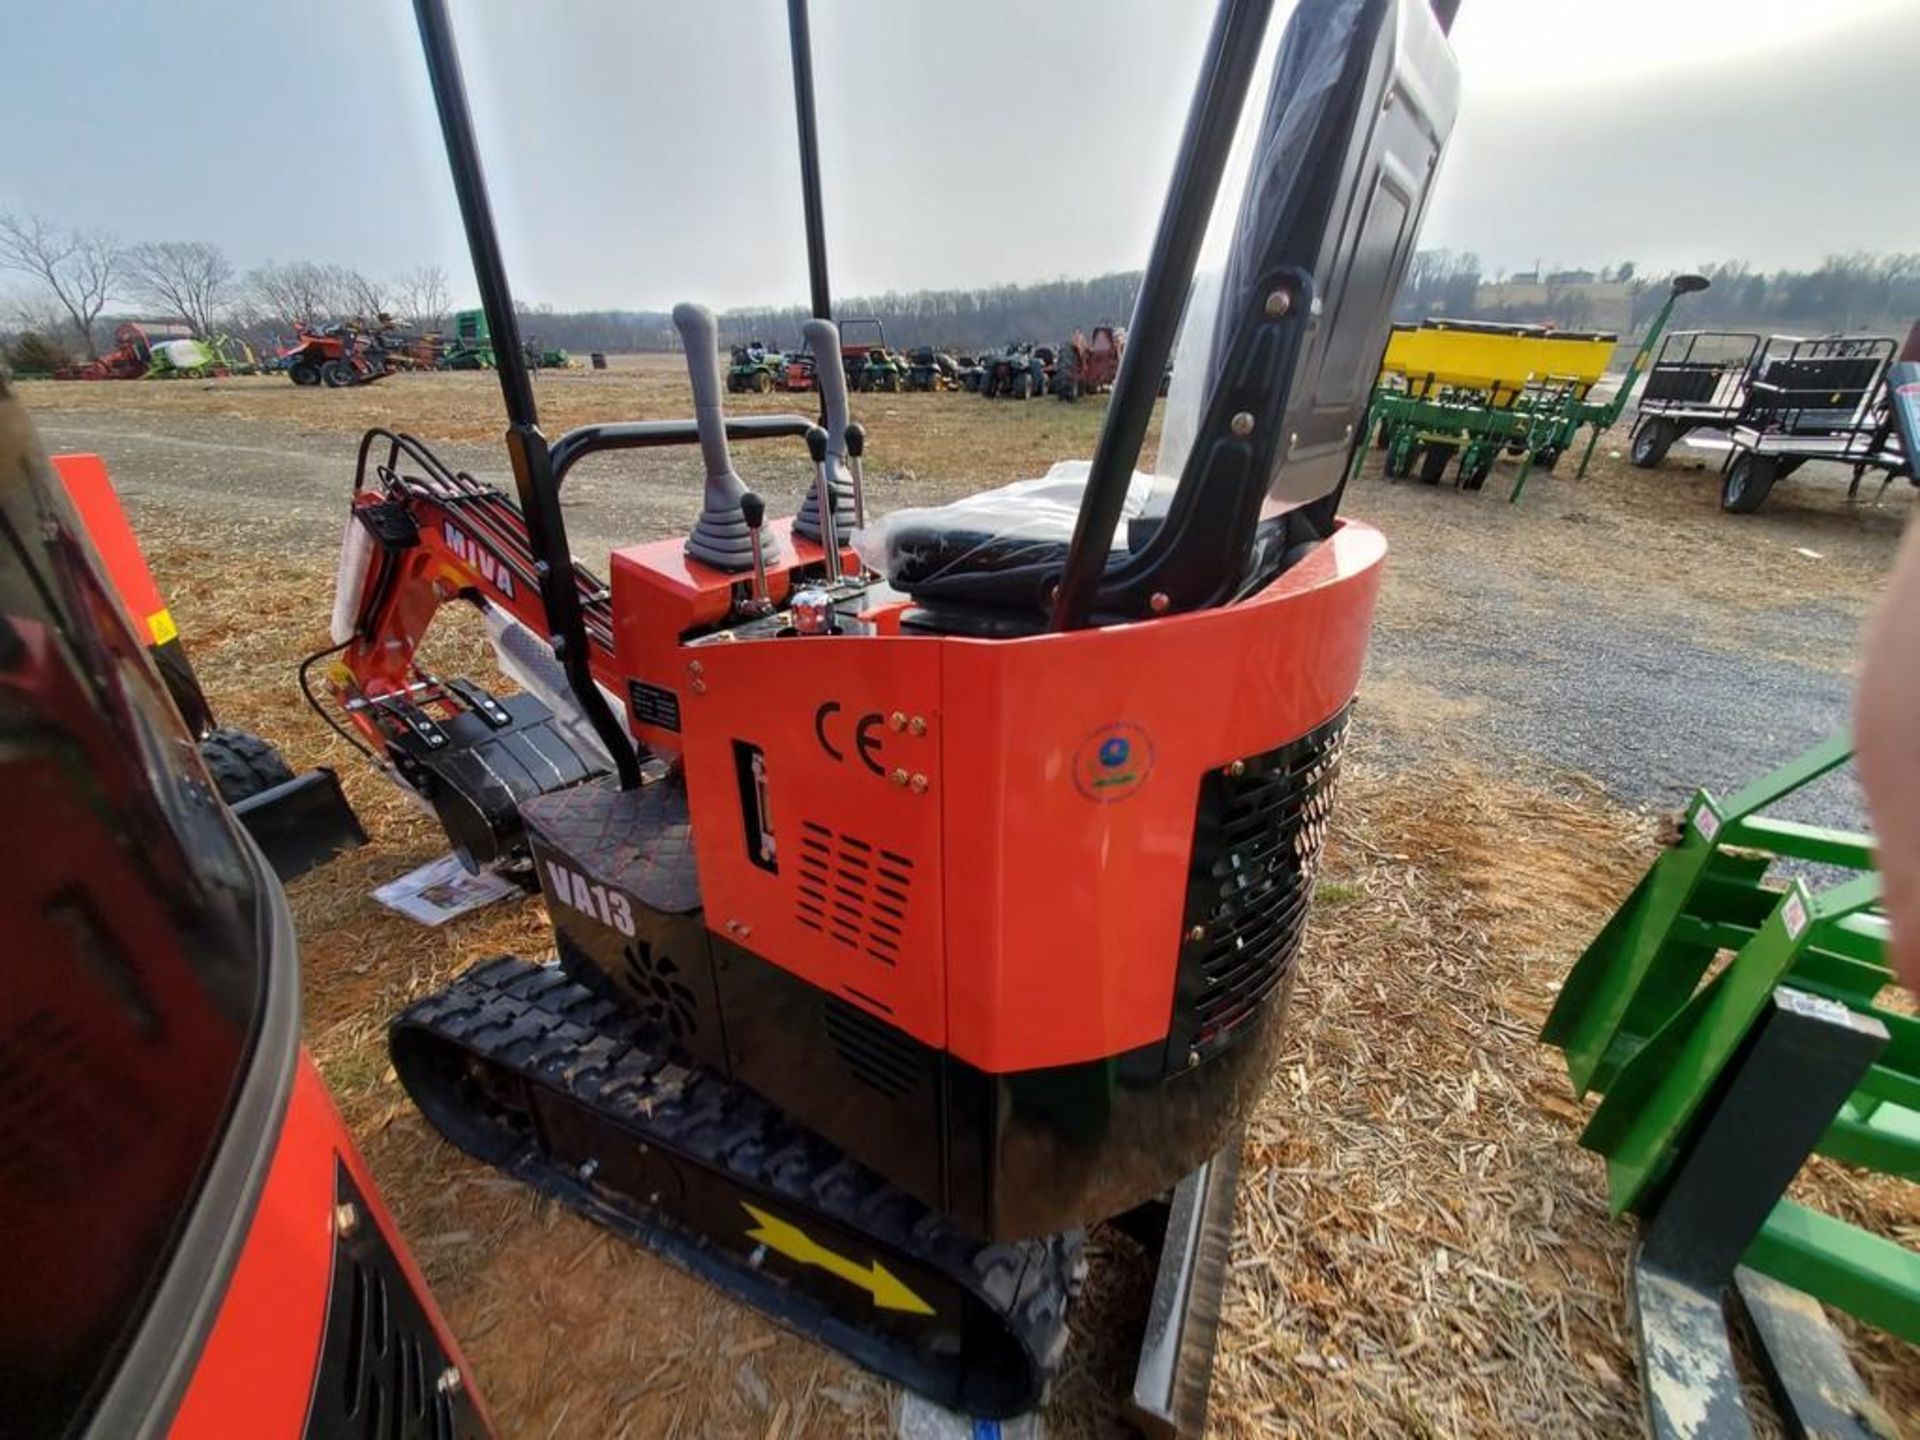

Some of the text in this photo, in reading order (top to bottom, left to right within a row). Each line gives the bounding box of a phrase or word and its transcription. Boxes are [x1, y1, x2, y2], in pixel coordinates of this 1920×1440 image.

[444, 521, 515, 600] MIVA
[815, 701, 887, 778] CE
[545, 860, 636, 937] VA13
